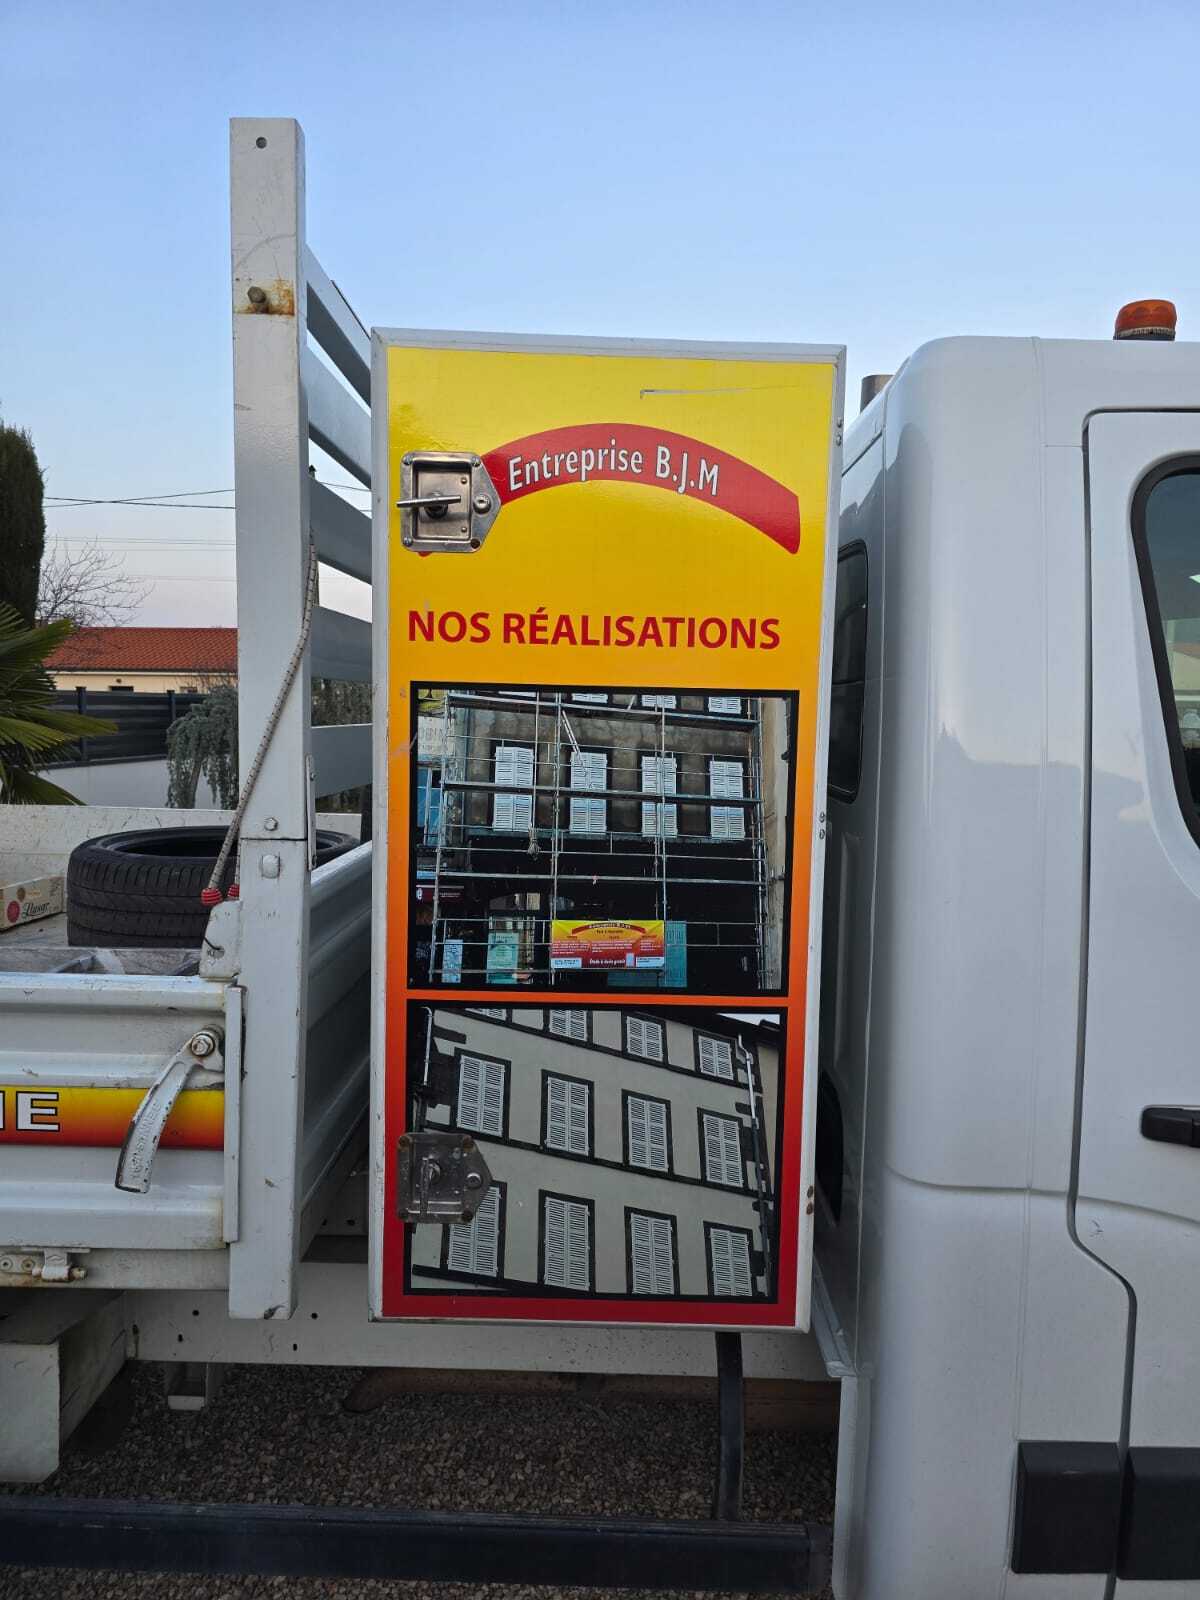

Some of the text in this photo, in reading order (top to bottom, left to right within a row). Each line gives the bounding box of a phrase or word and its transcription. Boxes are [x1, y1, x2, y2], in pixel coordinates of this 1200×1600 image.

[508, 438, 720, 496] Entreprise B.J.M
[408, 606, 781, 650] NOS RÉALISATIONS
[0, 1091, 60, 1131] E
